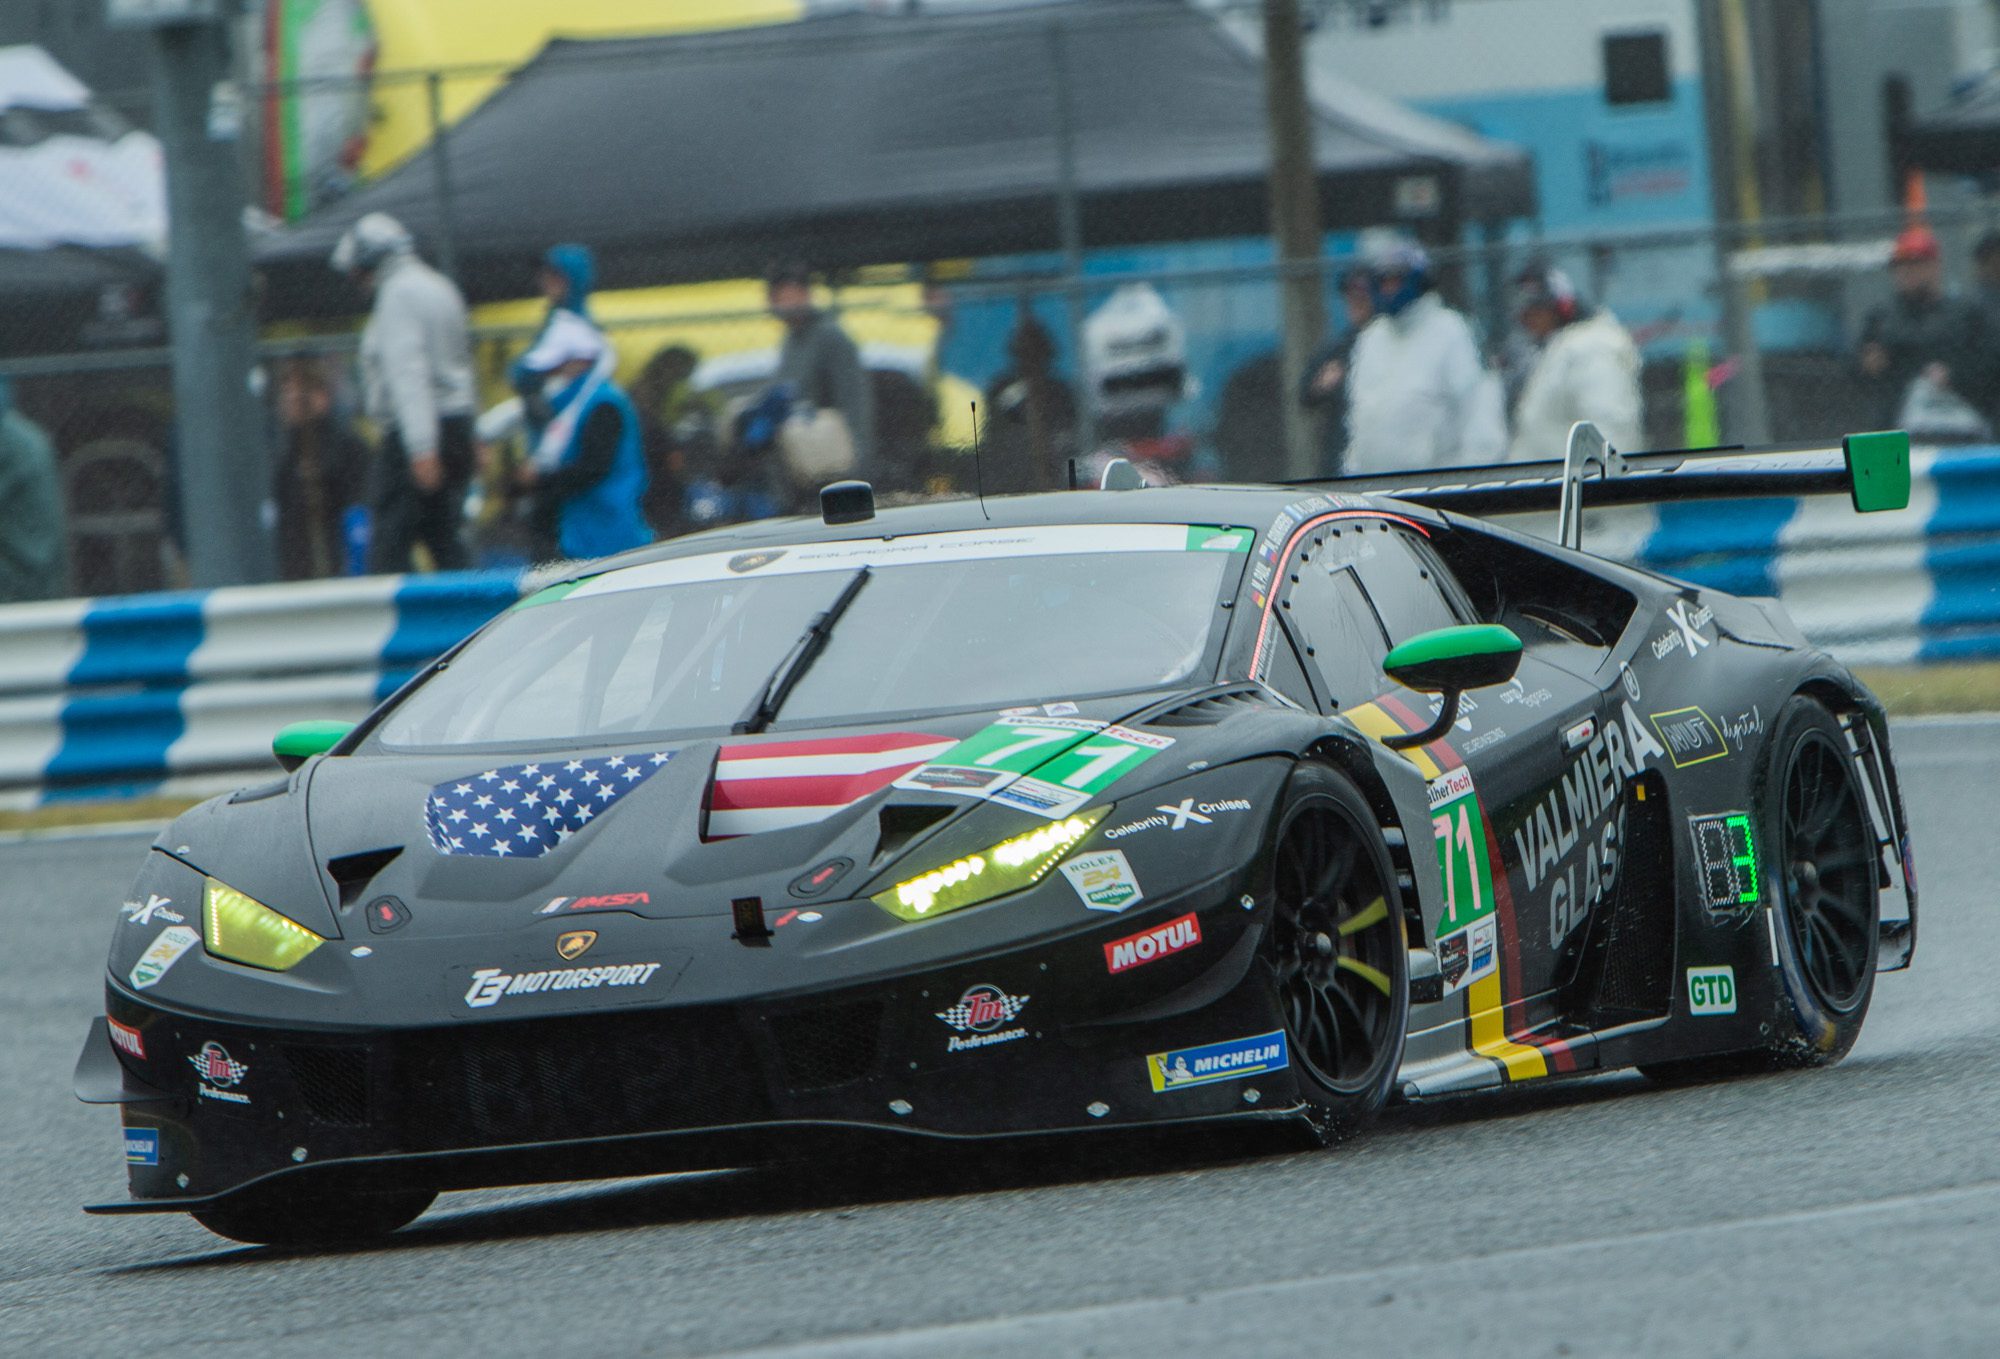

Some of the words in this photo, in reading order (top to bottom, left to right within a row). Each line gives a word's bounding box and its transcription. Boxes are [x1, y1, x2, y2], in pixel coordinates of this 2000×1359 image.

[1720, 704, 1764, 751] digital
[974, 726, 1140, 789] 71
[1514, 701, 1665, 892] VALMIERA
[1104, 813, 1170, 840] Celebrity
[1155, 798, 1214, 831] X
[1198, 799, 1251, 815] Cruises
[1069, 854, 1118, 874] ROLEX
[1082, 865, 1122, 887] 24
[1432, 804, 1482, 922] 71
[1111, 919, 1198, 970] MOTUL
[505, 962, 662, 995] MOTORSPORT
[1690, 974, 1733, 1007] GTD
[1193, 1043, 1280, 1073] MICHELIN
